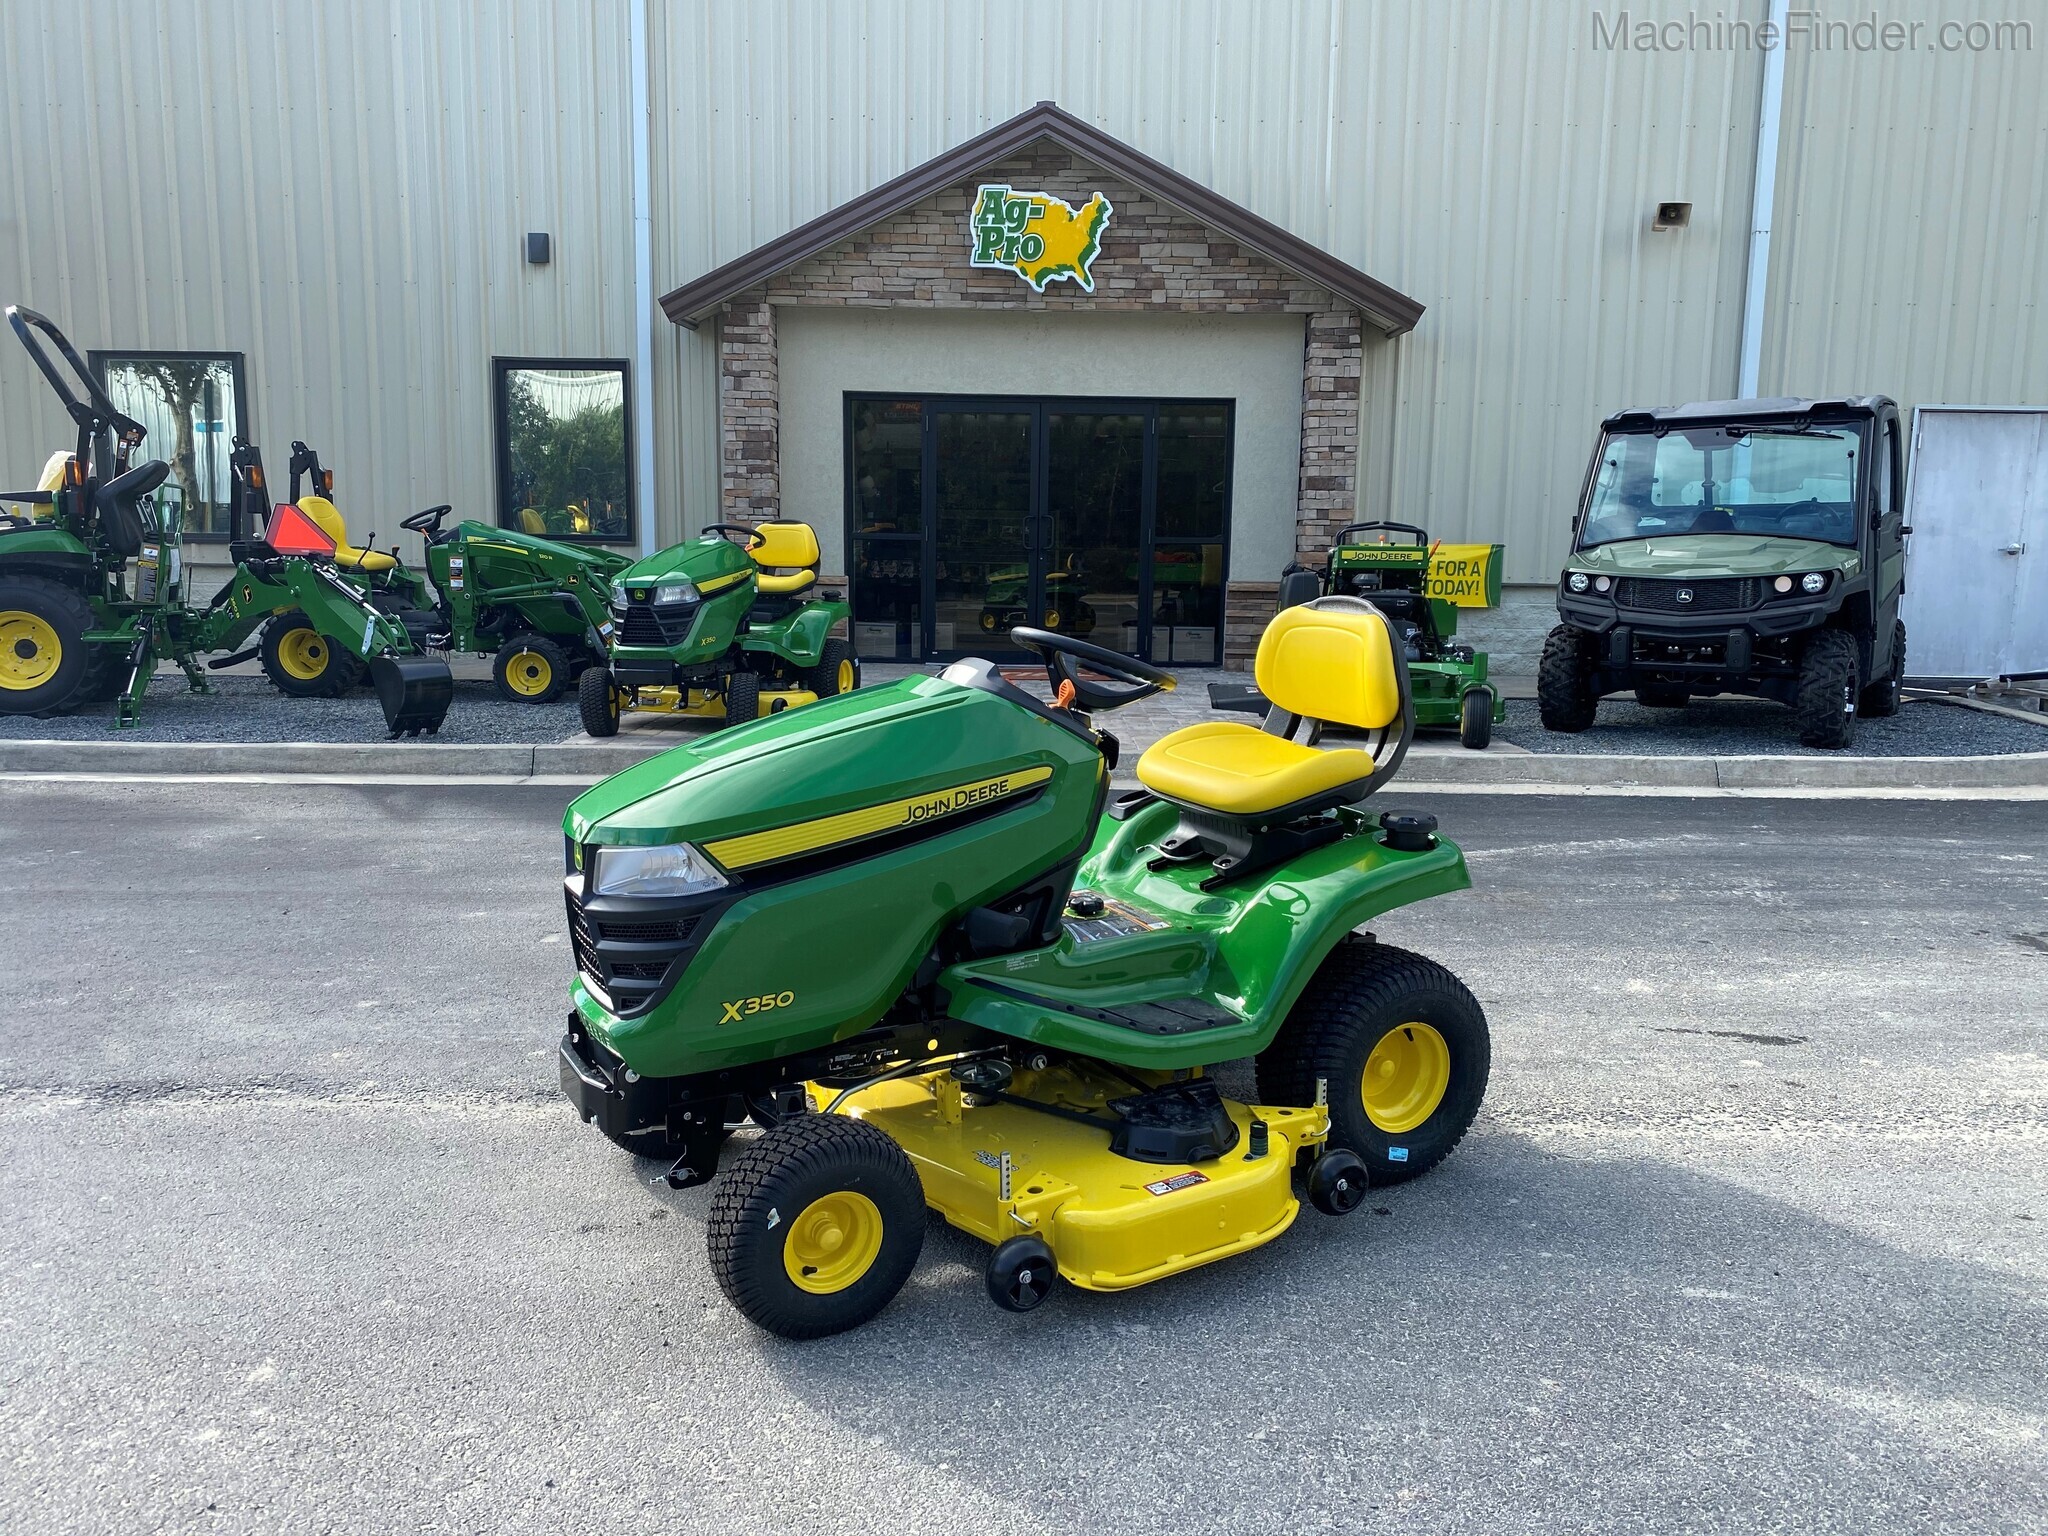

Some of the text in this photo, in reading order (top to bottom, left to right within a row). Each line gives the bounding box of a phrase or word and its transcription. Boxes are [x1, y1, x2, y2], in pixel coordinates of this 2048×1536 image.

[975, 188, 1045, 234] Ag-
[974, 225, 1045, 263] Pro
[1351, 551, 1413, 561] JOHN DEERE
[1437, 560, 1468, 577] FOR
[1470, 561, 1481, 577] A
[1426, 579, 1480, 596] TODAY!
[901, 778, 1010, 825] JOHN DEERE
[717, 990, 795, 1025] X350
